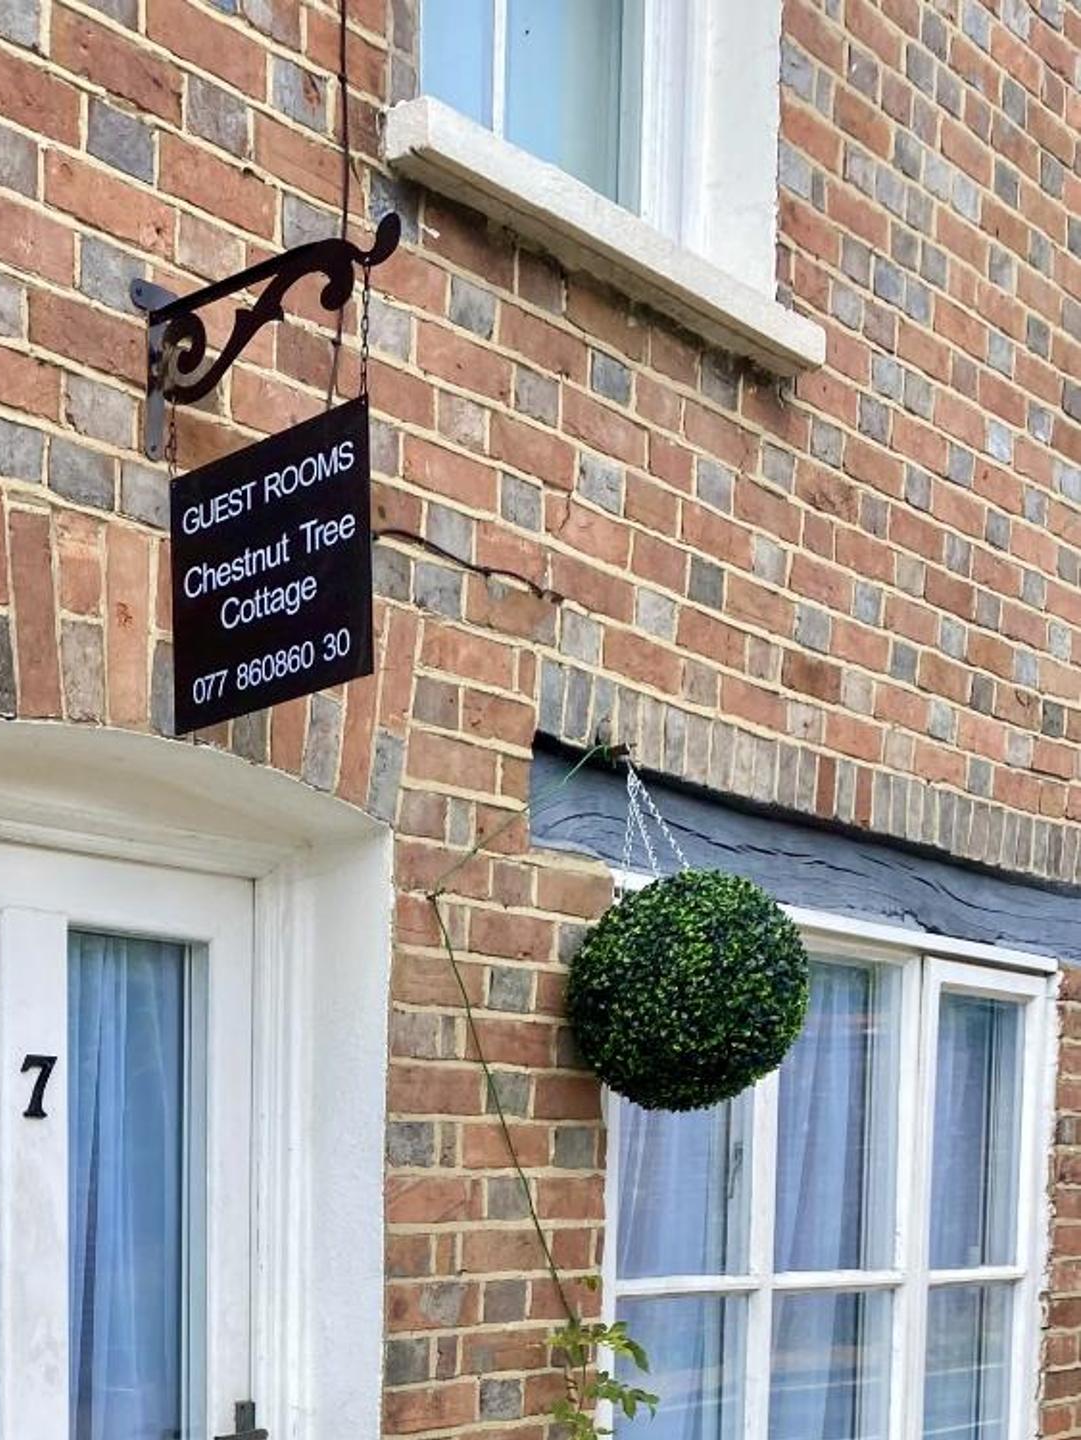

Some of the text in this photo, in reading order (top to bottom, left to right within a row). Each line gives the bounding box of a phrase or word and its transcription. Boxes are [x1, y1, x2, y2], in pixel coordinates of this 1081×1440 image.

[183, 441, 355, 535] GUEST ROOMS
[184, 513, 356, 598] Chestnut Tree
[220, 575, 318, 629] Cottage
[192, 628, 351, 704] 077 860860 30
[20, 1054, 58, 1120] 7
